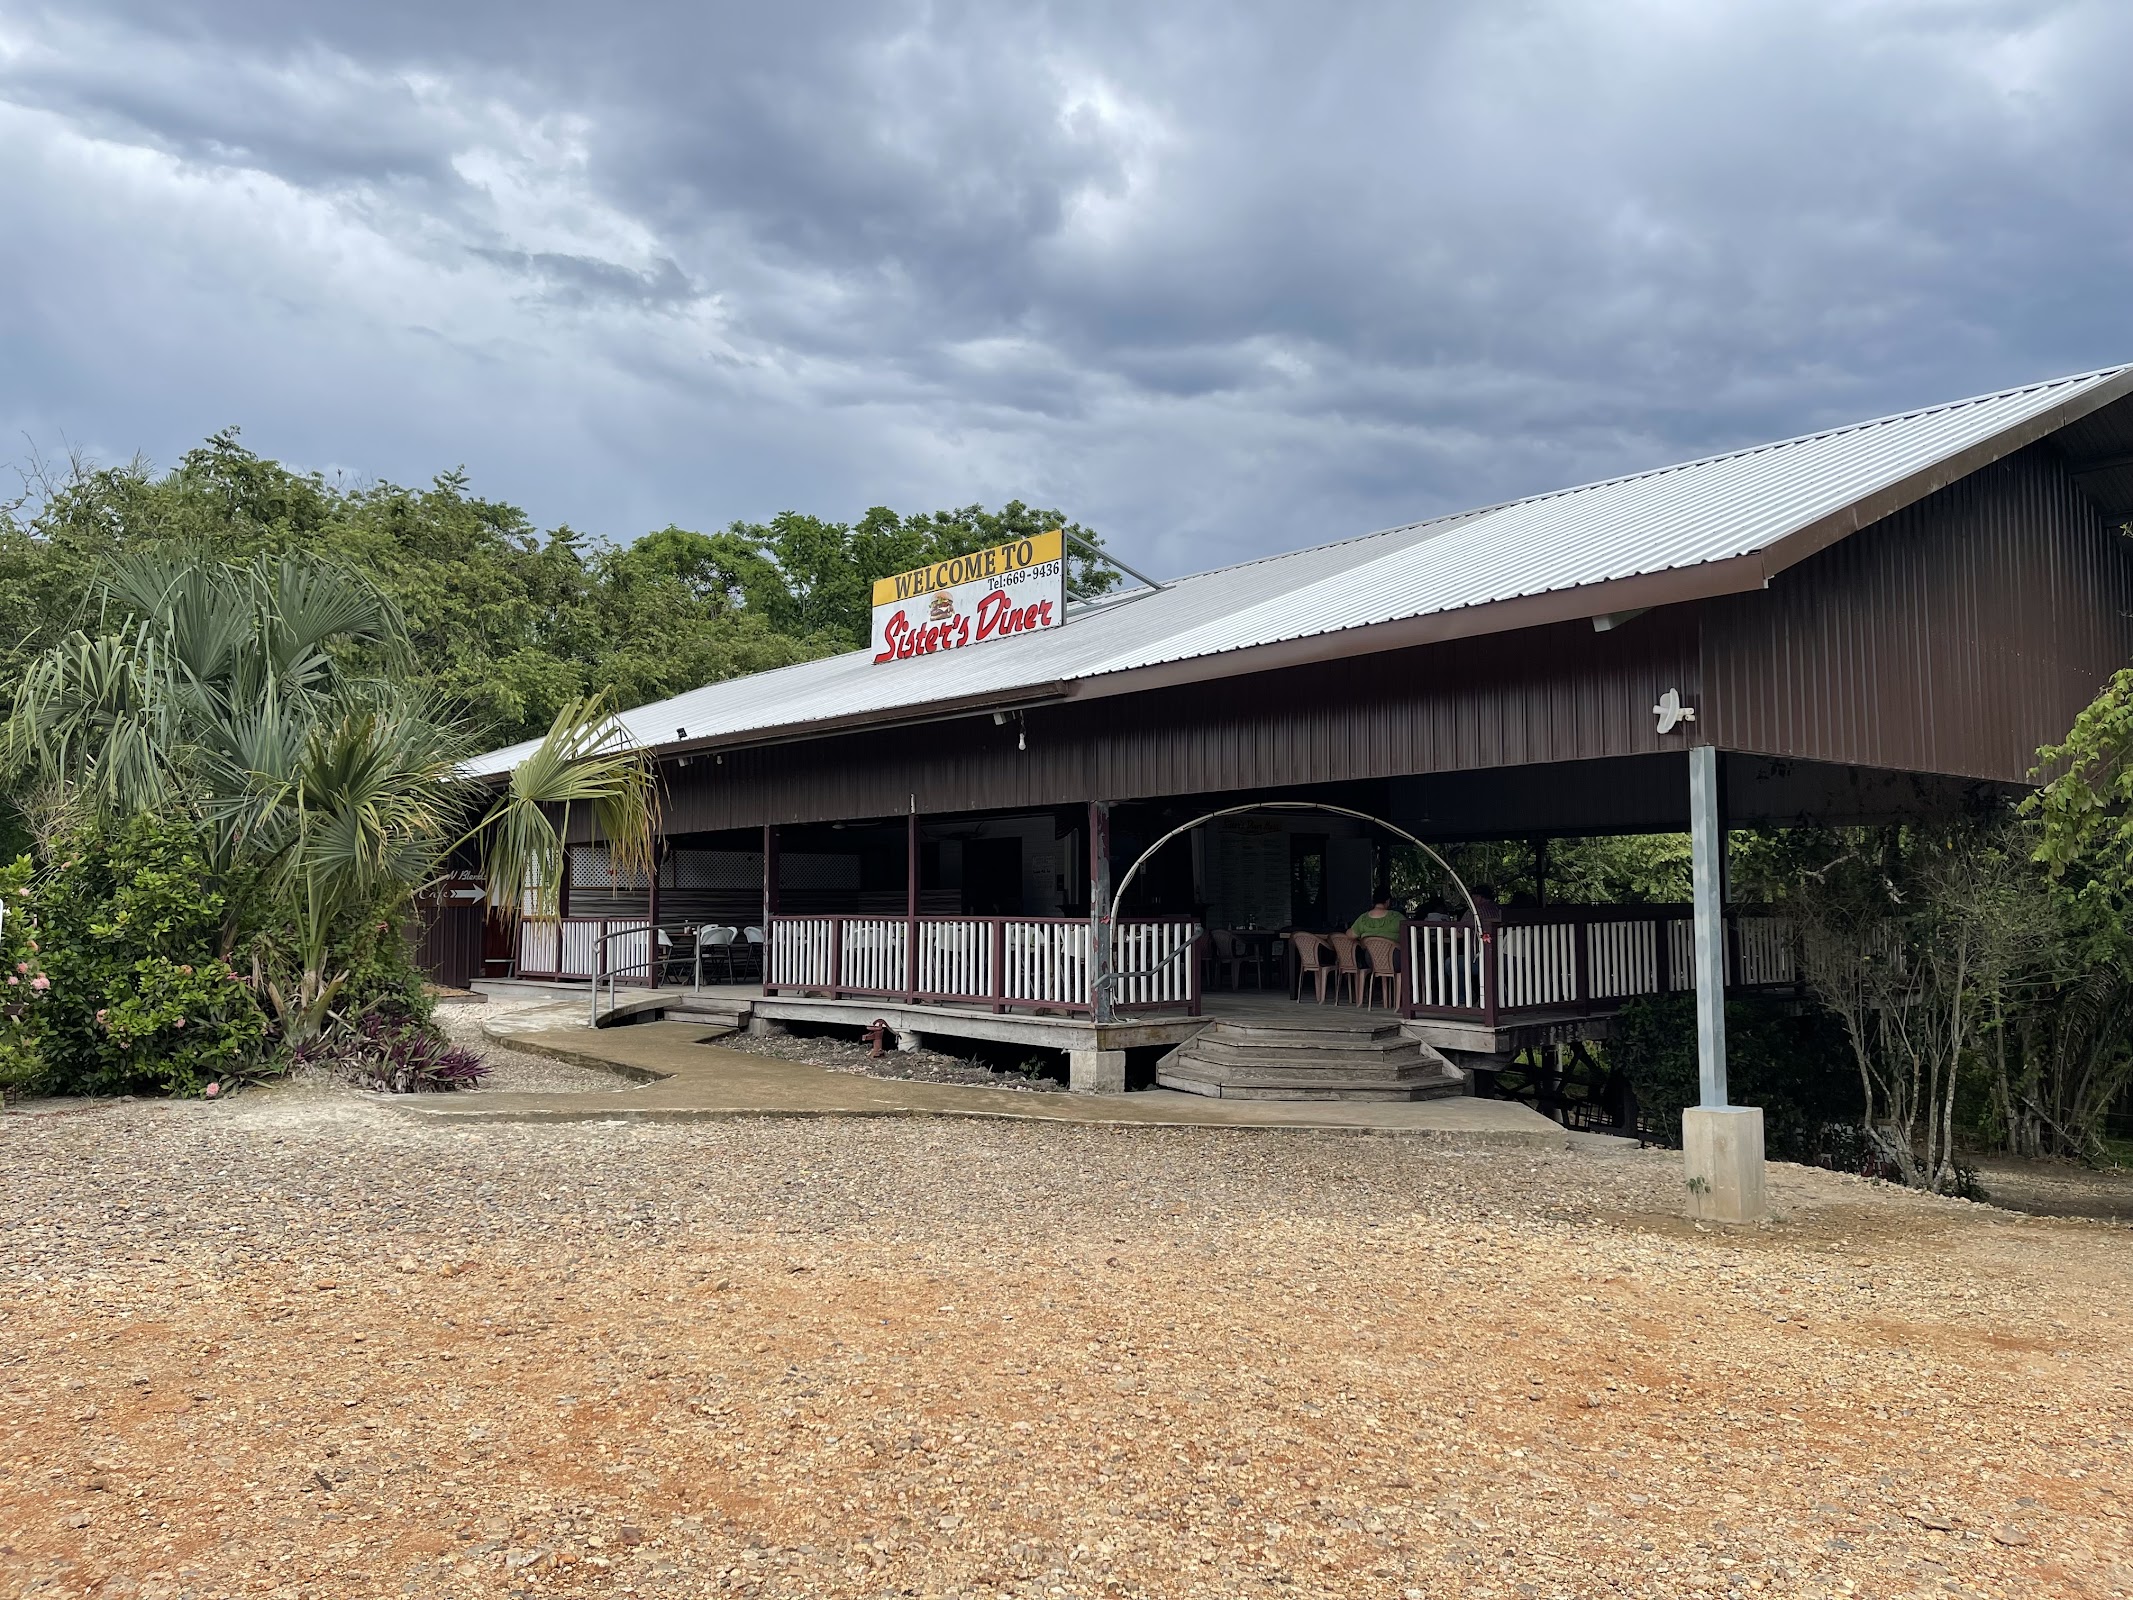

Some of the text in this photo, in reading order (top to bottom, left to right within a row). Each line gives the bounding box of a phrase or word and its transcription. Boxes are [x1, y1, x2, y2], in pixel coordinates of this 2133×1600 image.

[895, 540, 1033, 599] WELCOME TO
[987, 561, 1060, 591] Tel:669-9436
[873, 589, 1054, 664] Sister's Diner
